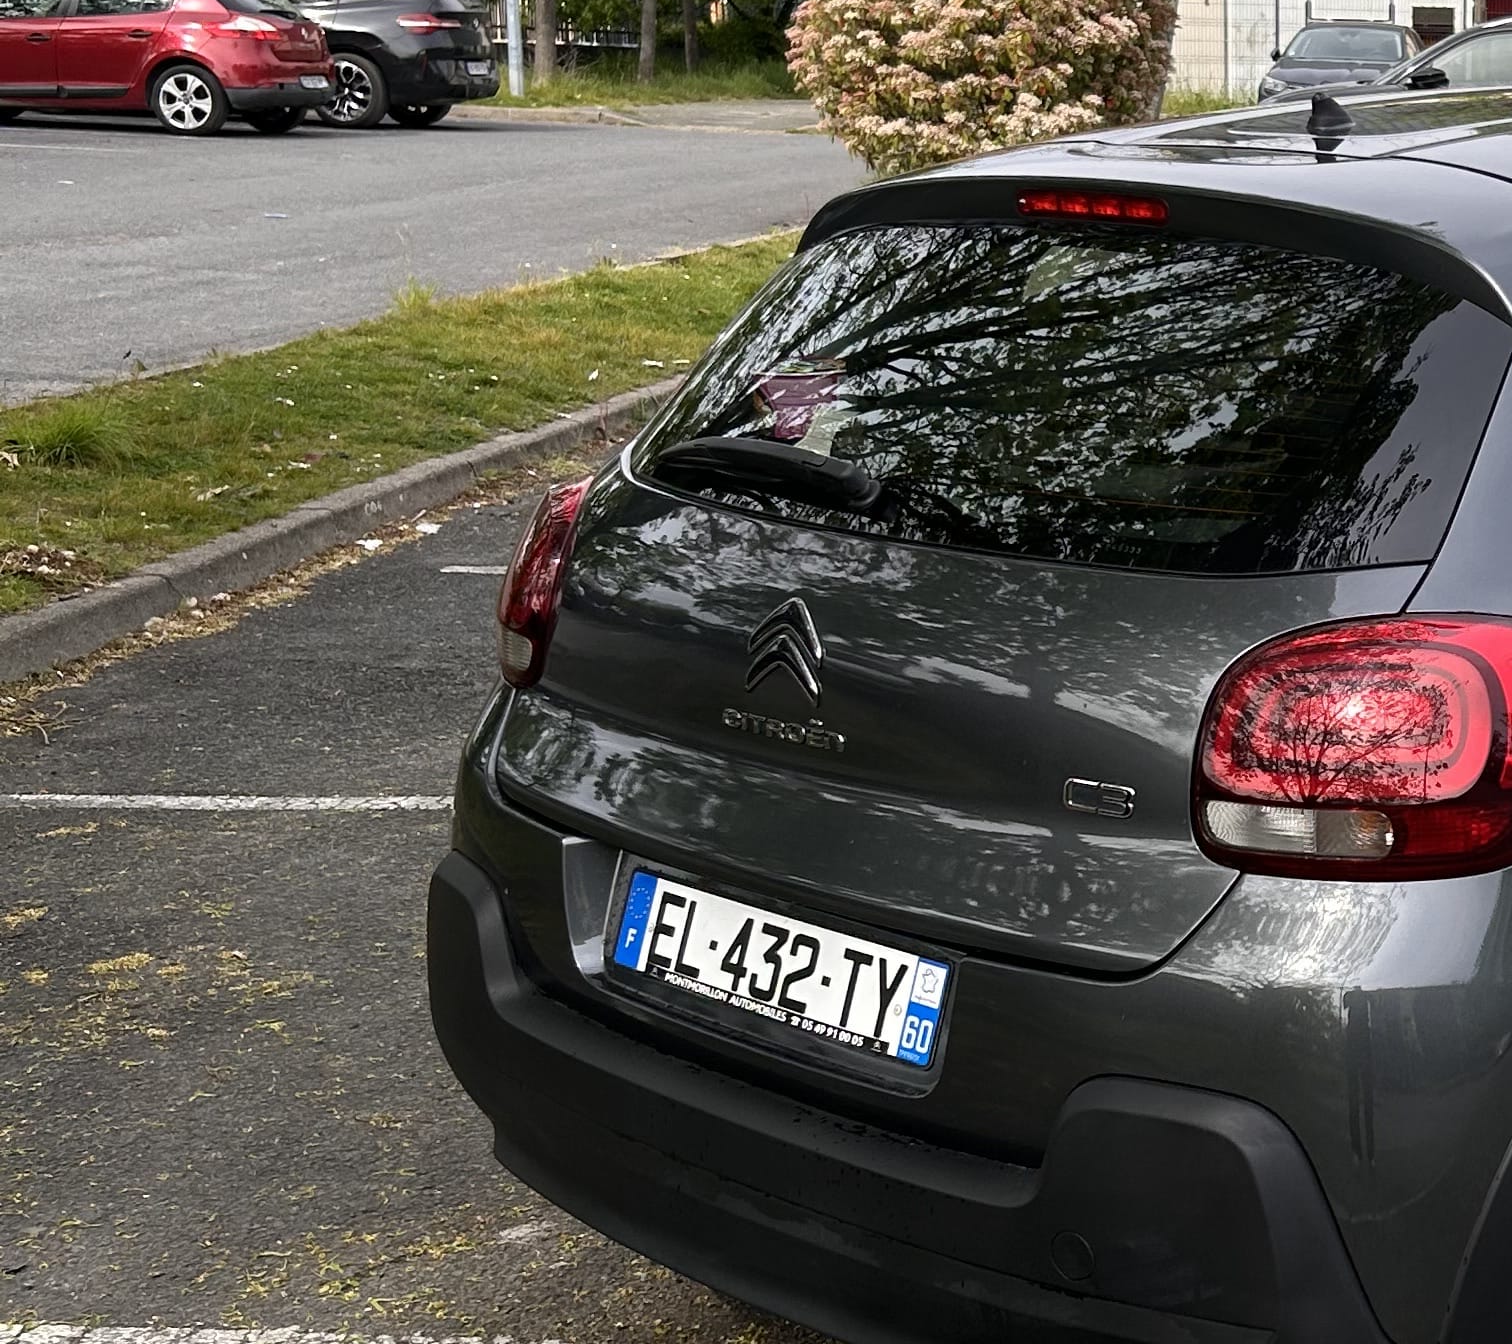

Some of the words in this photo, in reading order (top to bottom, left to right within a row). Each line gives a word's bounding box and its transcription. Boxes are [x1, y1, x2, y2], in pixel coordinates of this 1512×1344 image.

[1062, 777, 1136, 819] C3
[625, 927, 638, 949] F
[648, 890, 910, 1039] EL-432-TY
[664, 972, 729, 1003] MONTMORILLON
[729, 995, 788, 1023] AUTOMOBILES
[901, 1015, 934, 1054] 60
